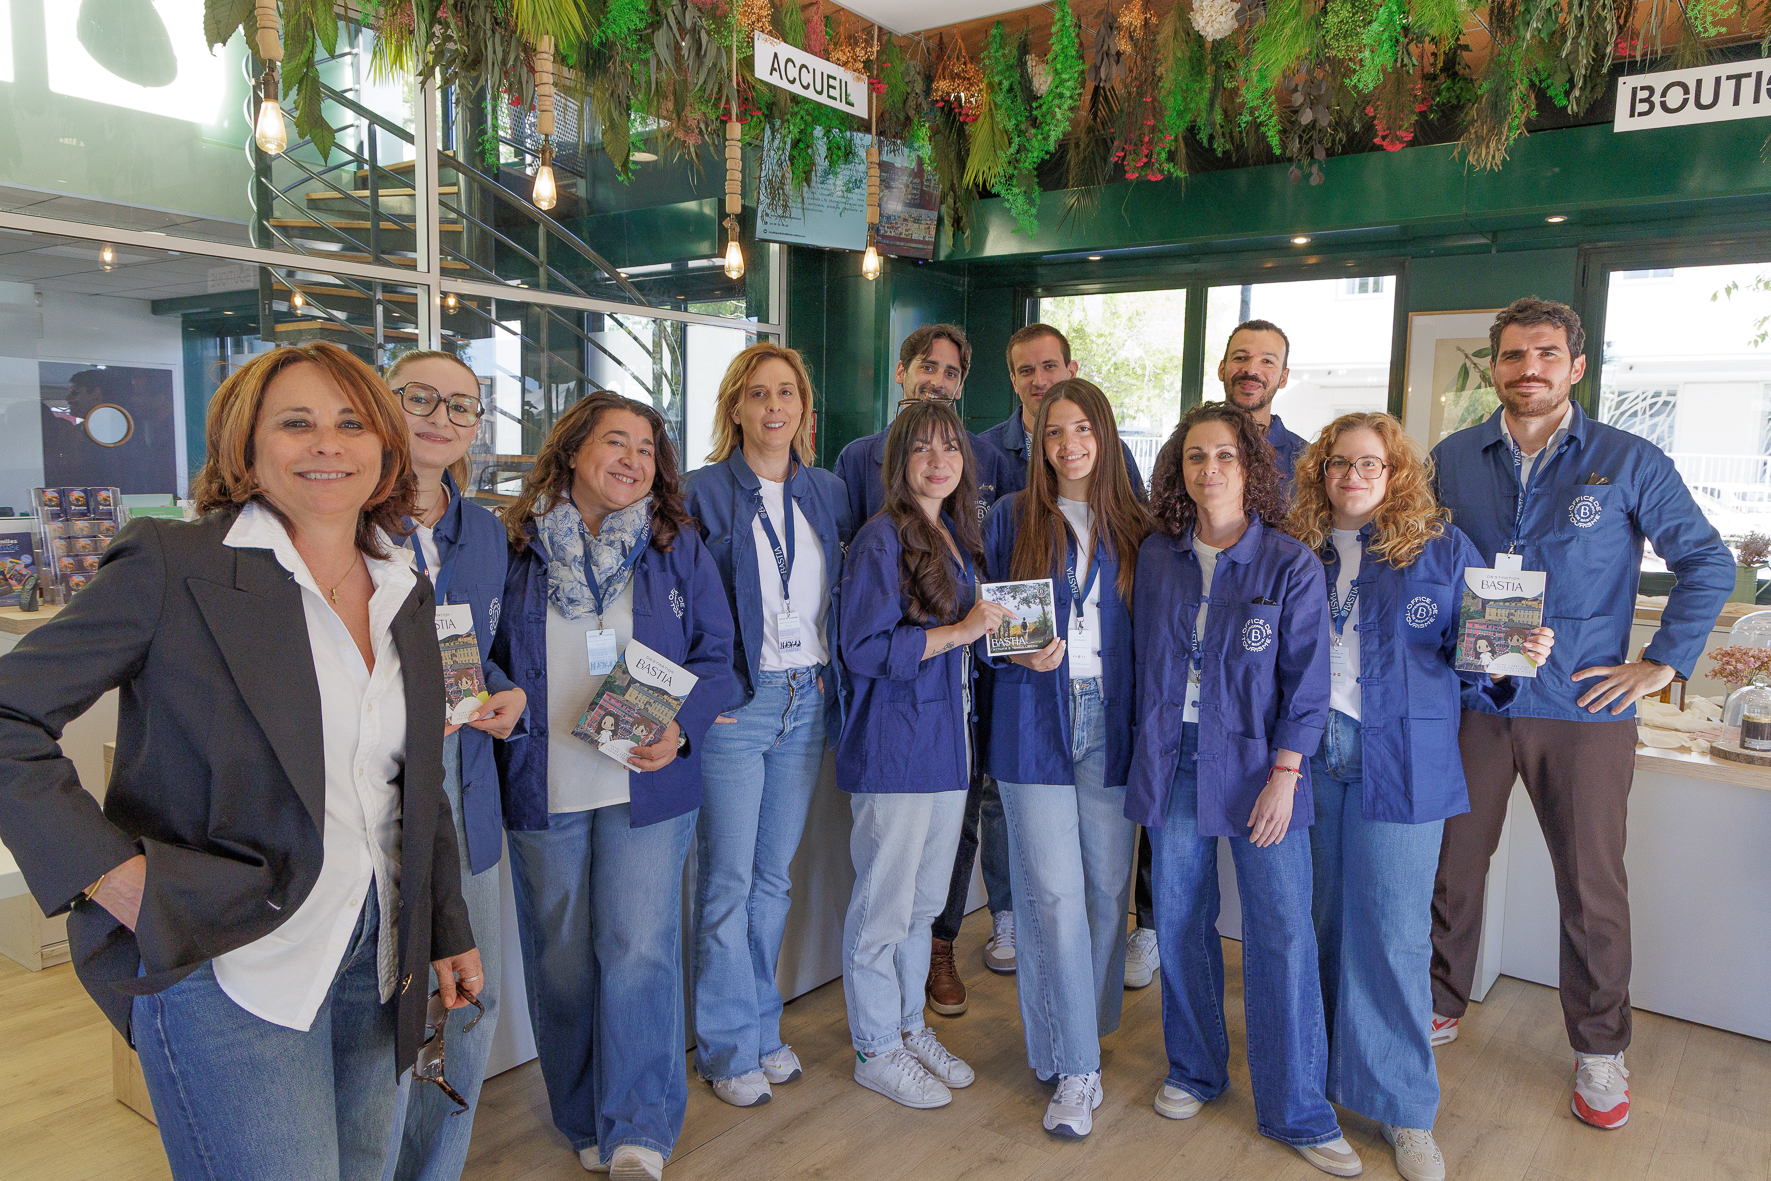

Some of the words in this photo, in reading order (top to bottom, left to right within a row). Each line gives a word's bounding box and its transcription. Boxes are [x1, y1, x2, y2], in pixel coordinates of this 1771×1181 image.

[769, 51, 855, 108] ACCUEIL
[1628, 70, 1771, 119] BOUTI
[1568, 495, 1595, 511] OFFICE
[1593, 500, 1602, 512] DE
[1580, 505, 1590, 518] B
[1568, 513, 1601, 529] TOURISME
[774, 546, 787, 574] BASTIA
[1066, 566, 1079, 594] BASTIA
[1481, 579, 1524, 592] BASTIA
[1330, 592, 1340, 619] BASTIA
[1406, 596, 1432, 610] OFFICE
[1431, 603, 1438, 615] DE
[1416, 606, 1427, 619] B
[1242, 618, 1265, 634] OFFICE
[1264, 623, 1272, 635] DE
[1405, 612, 1436, 629] TOURISME
[991, 636, 1026, 648] BASTIA
[1251, 629, 1261, 641] B
[1241, 636, 1271, 653] TOURISME
[636, 658, 673, 687] BASTIA
[645, 655, 675, 675] DESTINATION
